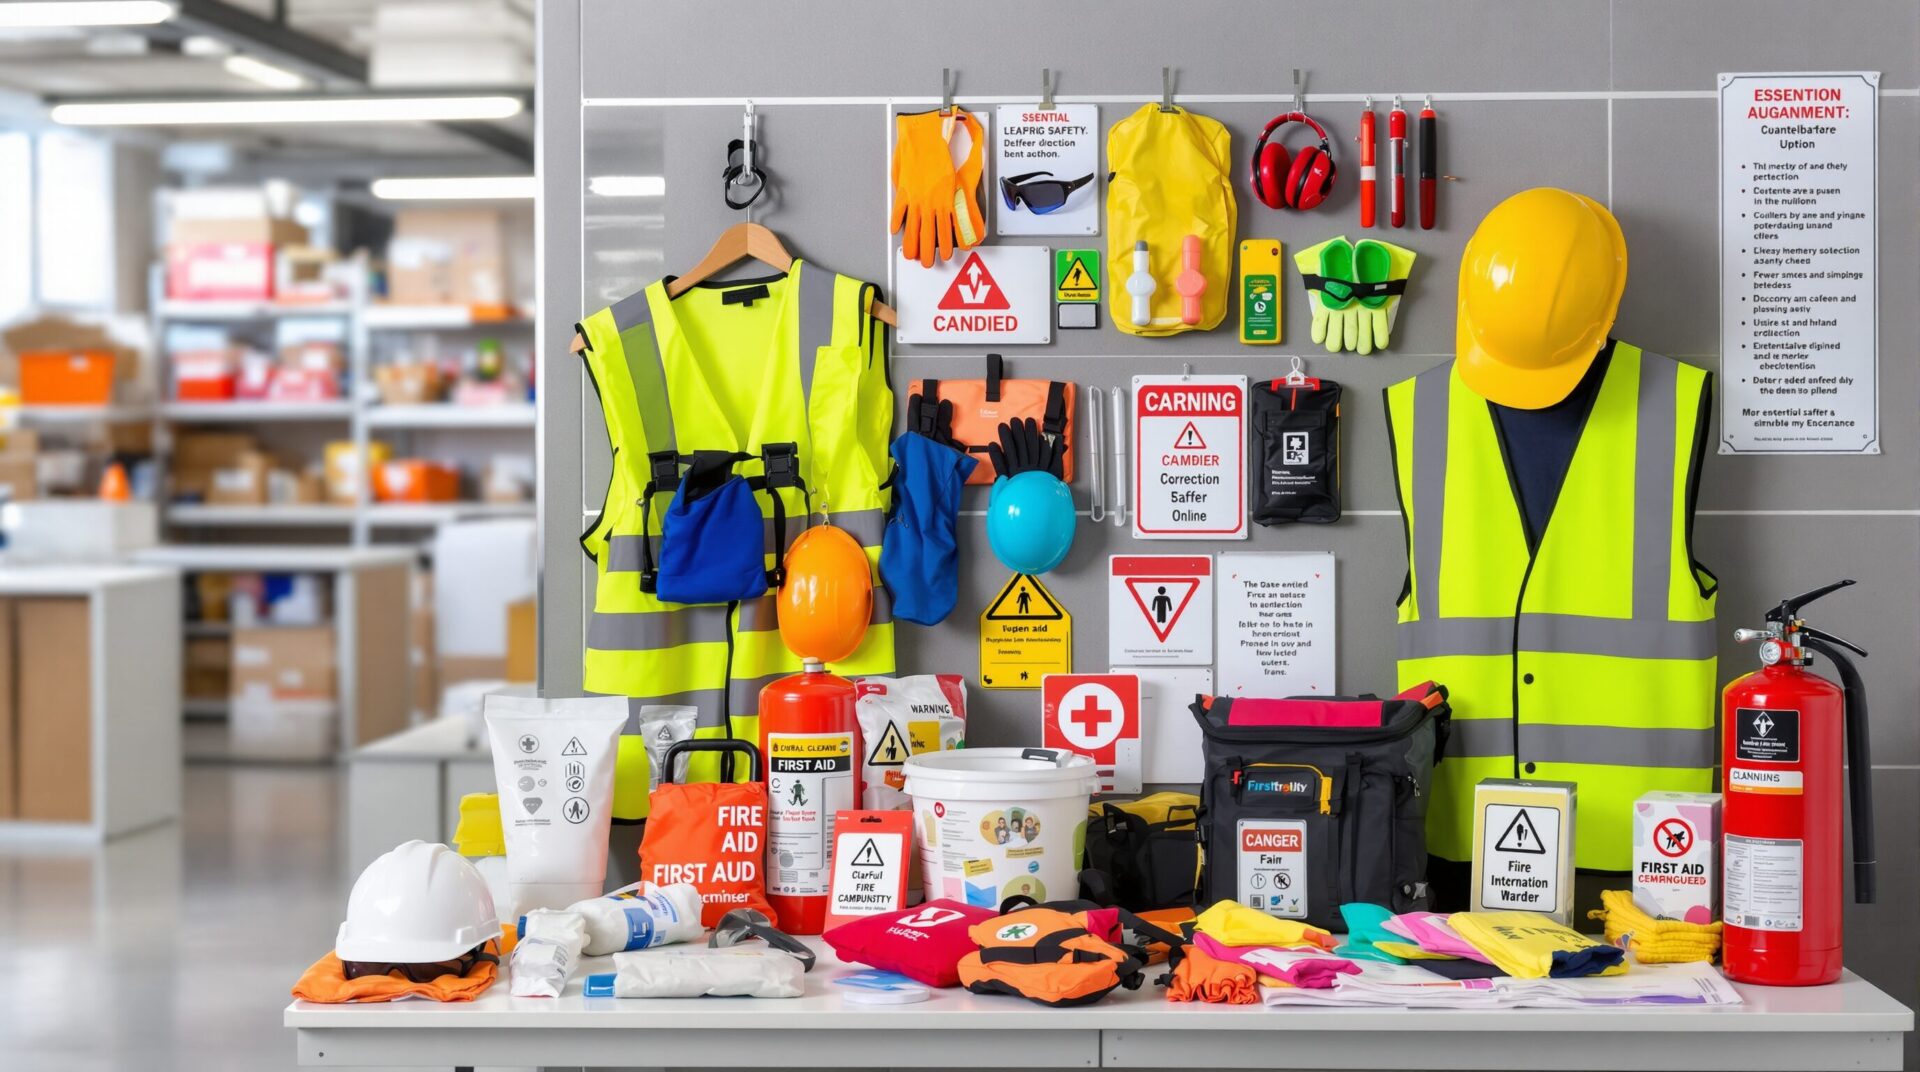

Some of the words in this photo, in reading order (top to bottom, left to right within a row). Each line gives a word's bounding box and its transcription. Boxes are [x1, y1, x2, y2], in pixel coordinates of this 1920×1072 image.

[1754, 88, 1841, 102] ESSENTION
[1022, 113, 1069, 122] SSENTIAL
[1748, 106, 1849, 119] AUGANMENT:
[1048, 126, 1088, 135] SAFETY.
[933, 315, 1018, 332] CANDIED
[1145, 392, 1236, 412] CARNING
[1160, 472, 1220, 485] Correction
[1172, 509, 1207, 522] Online
[910, 704, 951, 714] WARNING
[778, 759, 812, 771] FIRST
[814, 759, 836, 771] AID
[718, 806, 763, 827] FIRE
[721, 832, 758, 853] AID
[1246, 834, 1299, 848] CANGER
[654, 863, 707, 887] FIRST
[711, 861, 756, 883] AUD
[1641, 862, 1678, 874] FIRST
[1681, 863, 1705, 875] AID
[856, 883, 876, 892] FIRE
[1501, 890, 1540, 903] Warder
